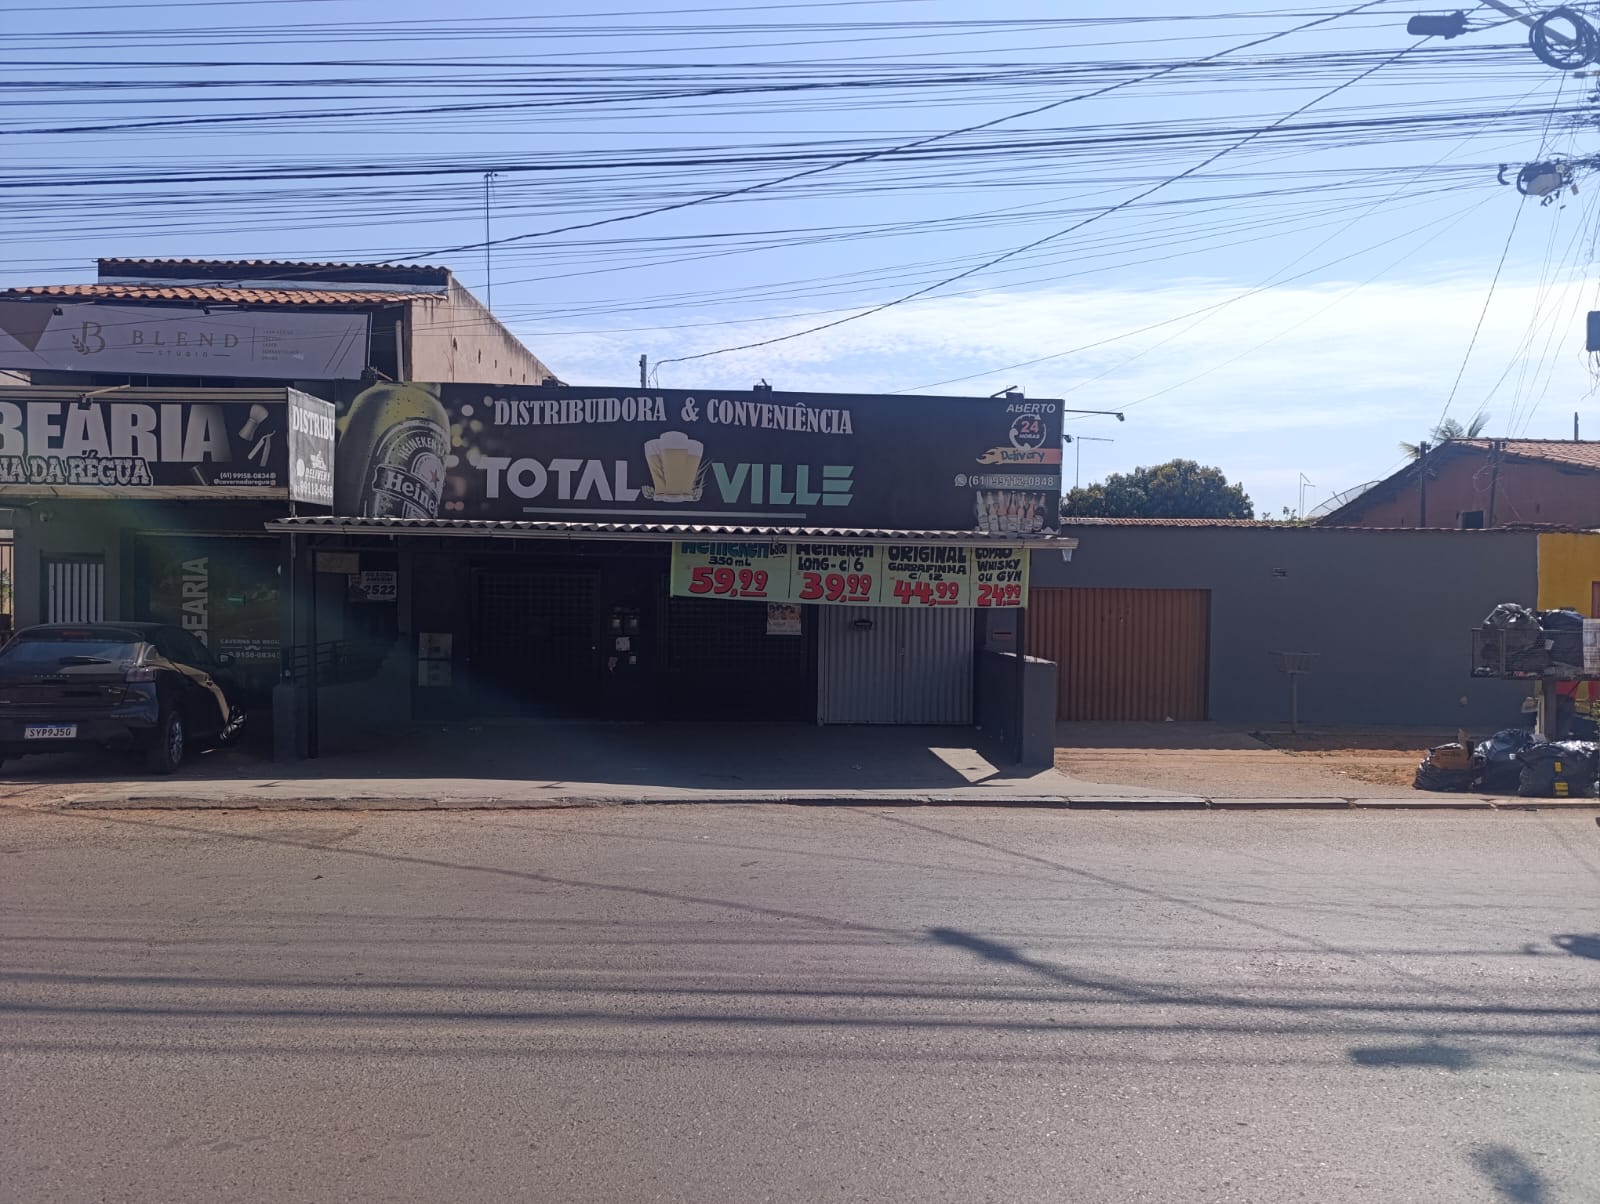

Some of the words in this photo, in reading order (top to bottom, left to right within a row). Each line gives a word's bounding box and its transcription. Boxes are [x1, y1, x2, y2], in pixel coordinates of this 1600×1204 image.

[132, 330, 239, 348] BLEND
[494, 397, 667, 425] DISTRIBUIDORA
[681, 396, 699, 422] &
[706, 399, 854, 434] CONVENIÊNCIA
[1006, 403, 1056, 414] ABERTO
[1021, 420, 1039, 433] 24
[29, 456, 66, 483] DA
[68, 451, 150, 485] RÉGUA
[475, 457, 641, 501] TOTAL
[711, 462, 854, 506] VILLE
[708, 556, 733, 566] 350
[888, 546, 967, 563] ORIGINAL
[888, 563, 967, 575] GARRAFINHA
[977, 559, 1021, 572] WHISKY
[688, 567, 769, 597] 59,99
[799, 572, 872, 603] 39,99
[893, 580, 959, 606] 44,99
[977, 583, 1021, 606] 24,99
